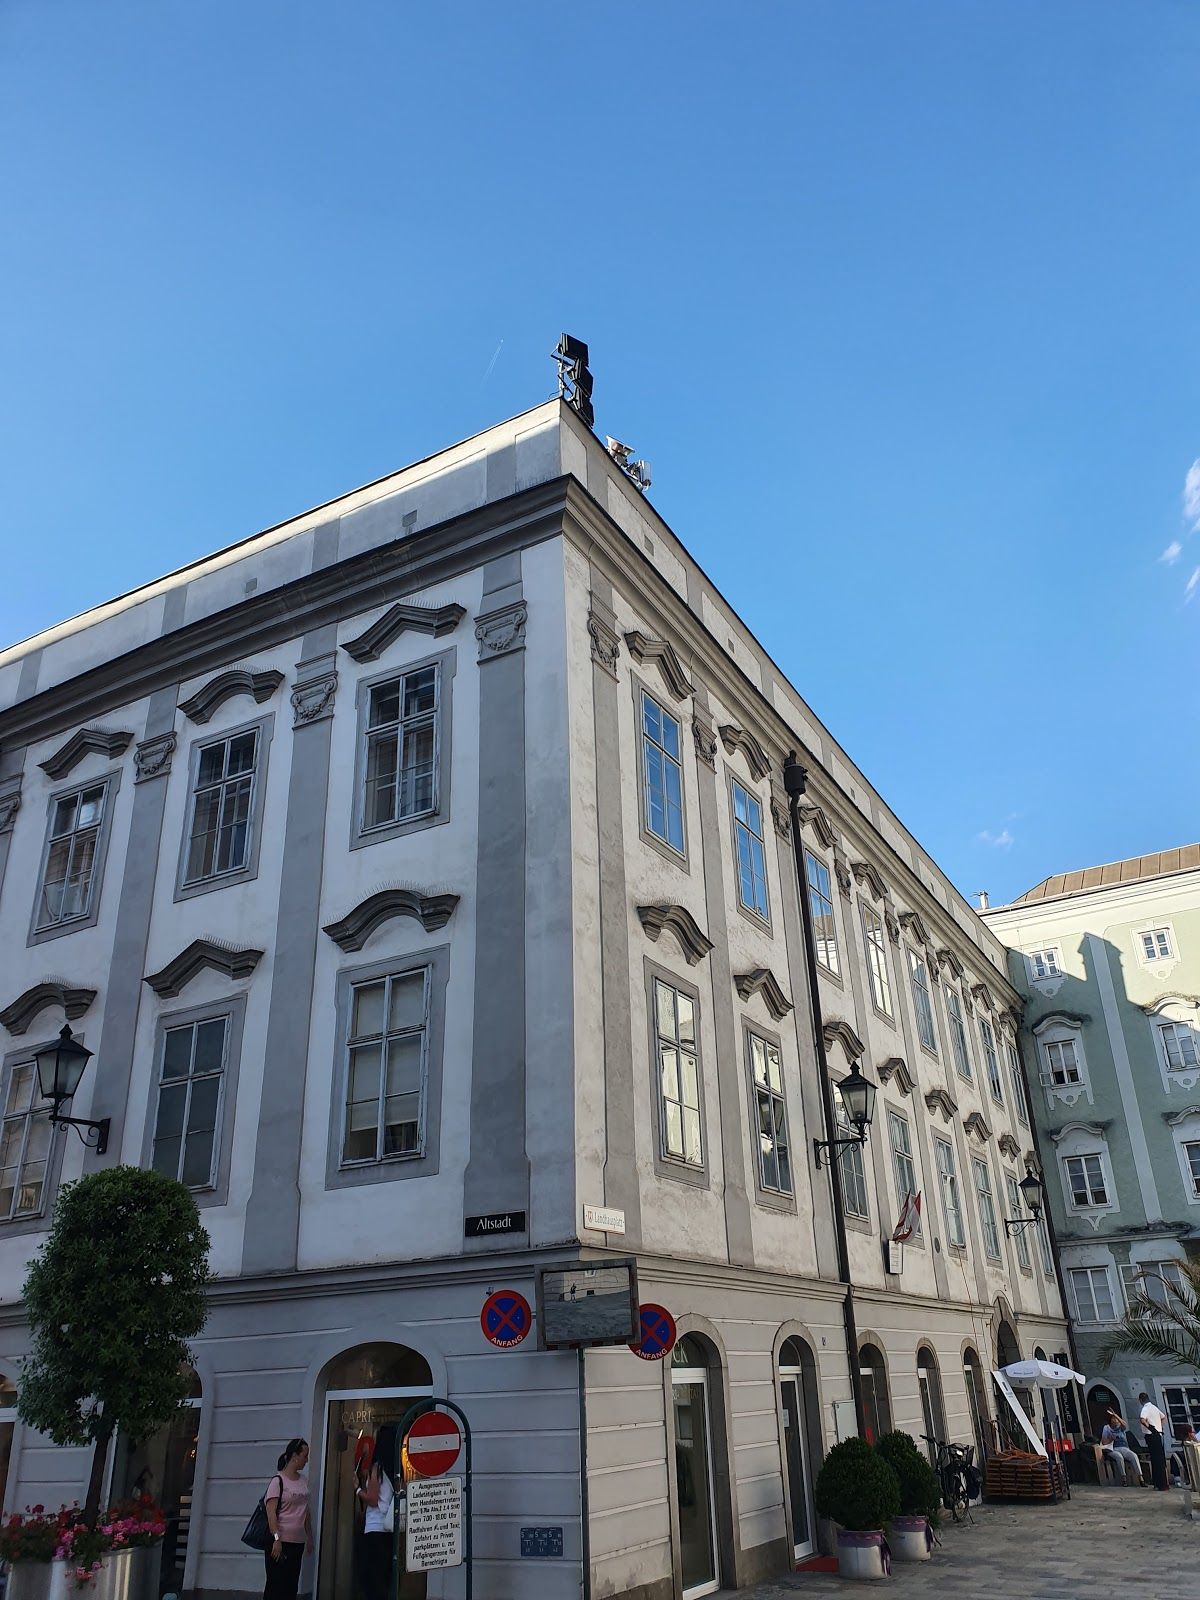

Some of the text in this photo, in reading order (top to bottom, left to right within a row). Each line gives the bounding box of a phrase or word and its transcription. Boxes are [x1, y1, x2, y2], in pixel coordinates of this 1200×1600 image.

[476, 1215, 512, 1230] Altstadt
[490, 1334, 523, 1347] ANFANG
[635, 1348, 668, 1359] ANFANG
[419, 1481, 452, 1490] Ausgenommen
[414, 1534, 432, 1543] Zufahrt
